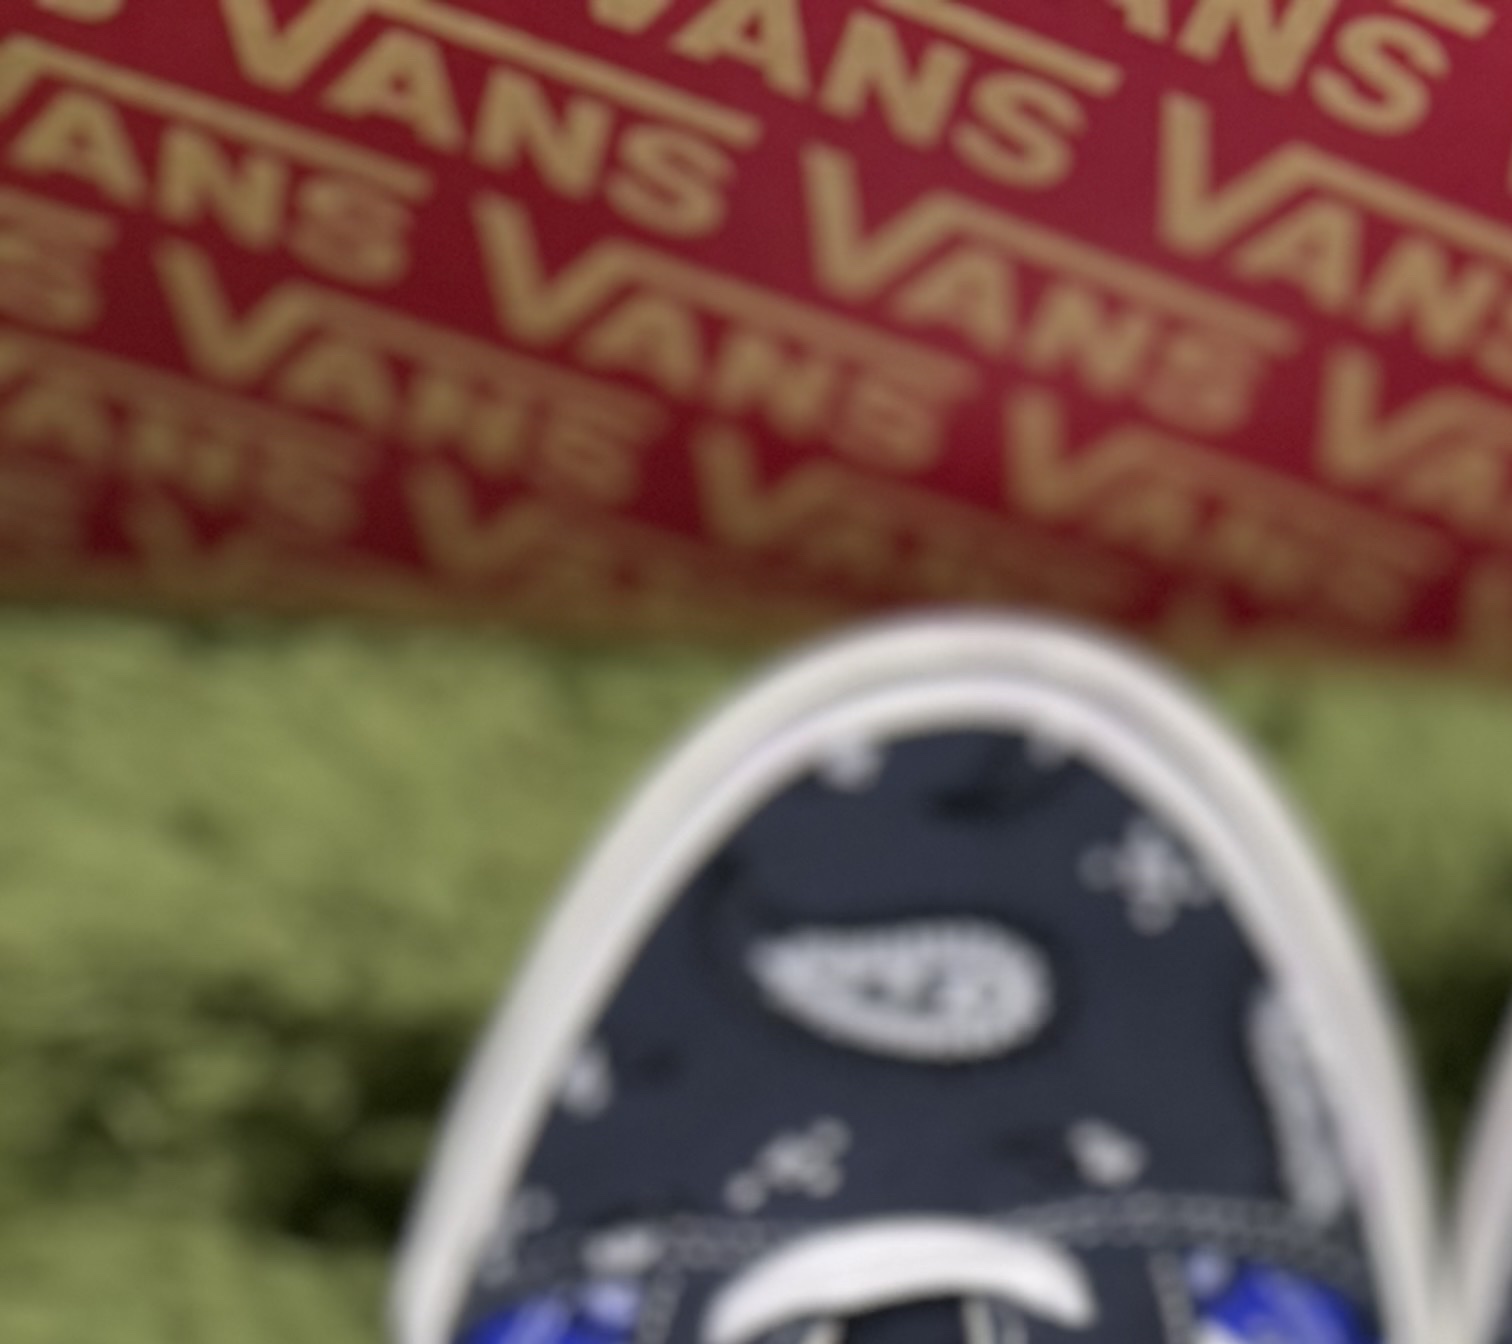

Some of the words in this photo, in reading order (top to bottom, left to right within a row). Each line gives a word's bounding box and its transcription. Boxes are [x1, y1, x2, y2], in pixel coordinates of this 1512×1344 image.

[590, 0, 1123, 188] ANS
[472, 190, 985, 473] VANS
[805, 140, 1302, 434] VANS
